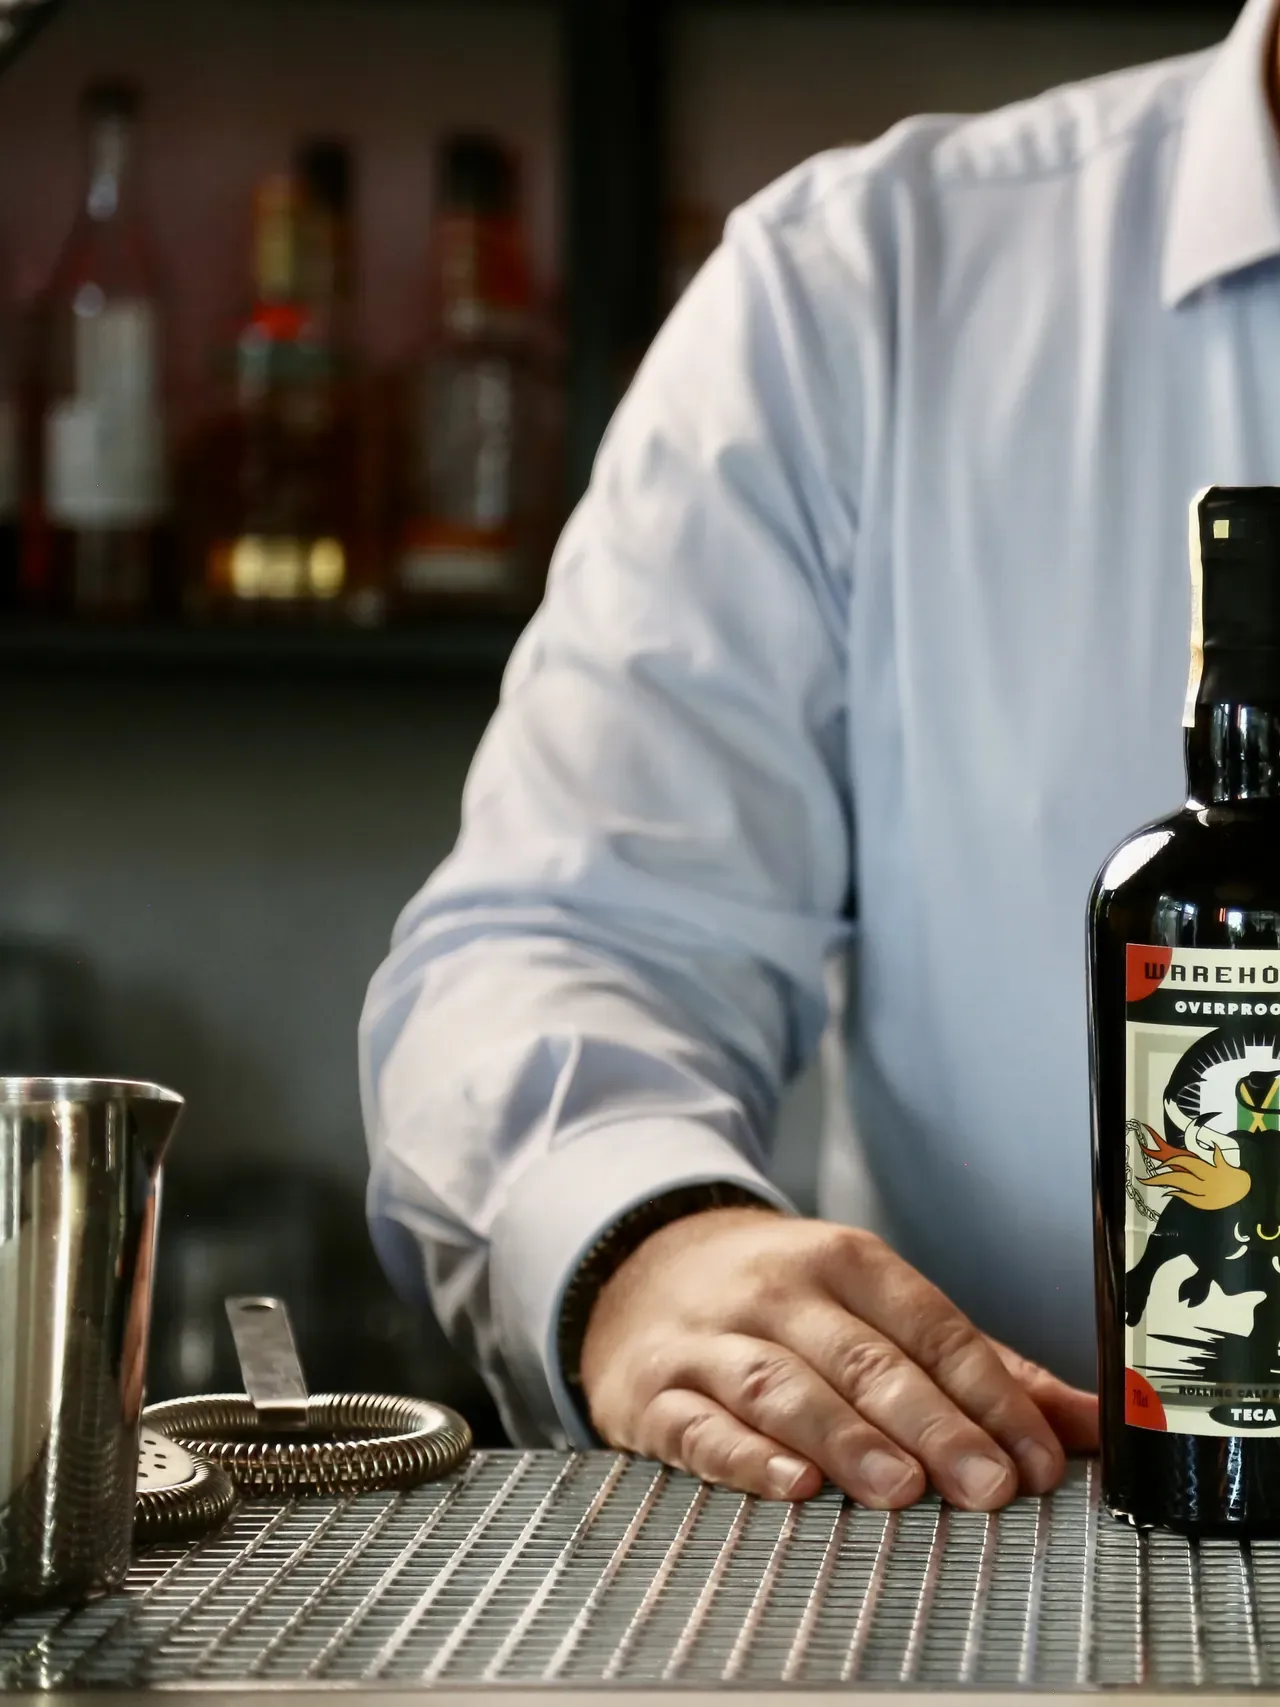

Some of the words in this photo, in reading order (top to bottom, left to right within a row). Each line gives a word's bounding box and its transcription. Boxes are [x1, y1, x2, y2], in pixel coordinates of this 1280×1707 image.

[1178, 1386, 1232, 1398] ROLLING
[1238, 1388, 1269, 1398] CALF
[1230, 1408, 1277, 1421] TECA
